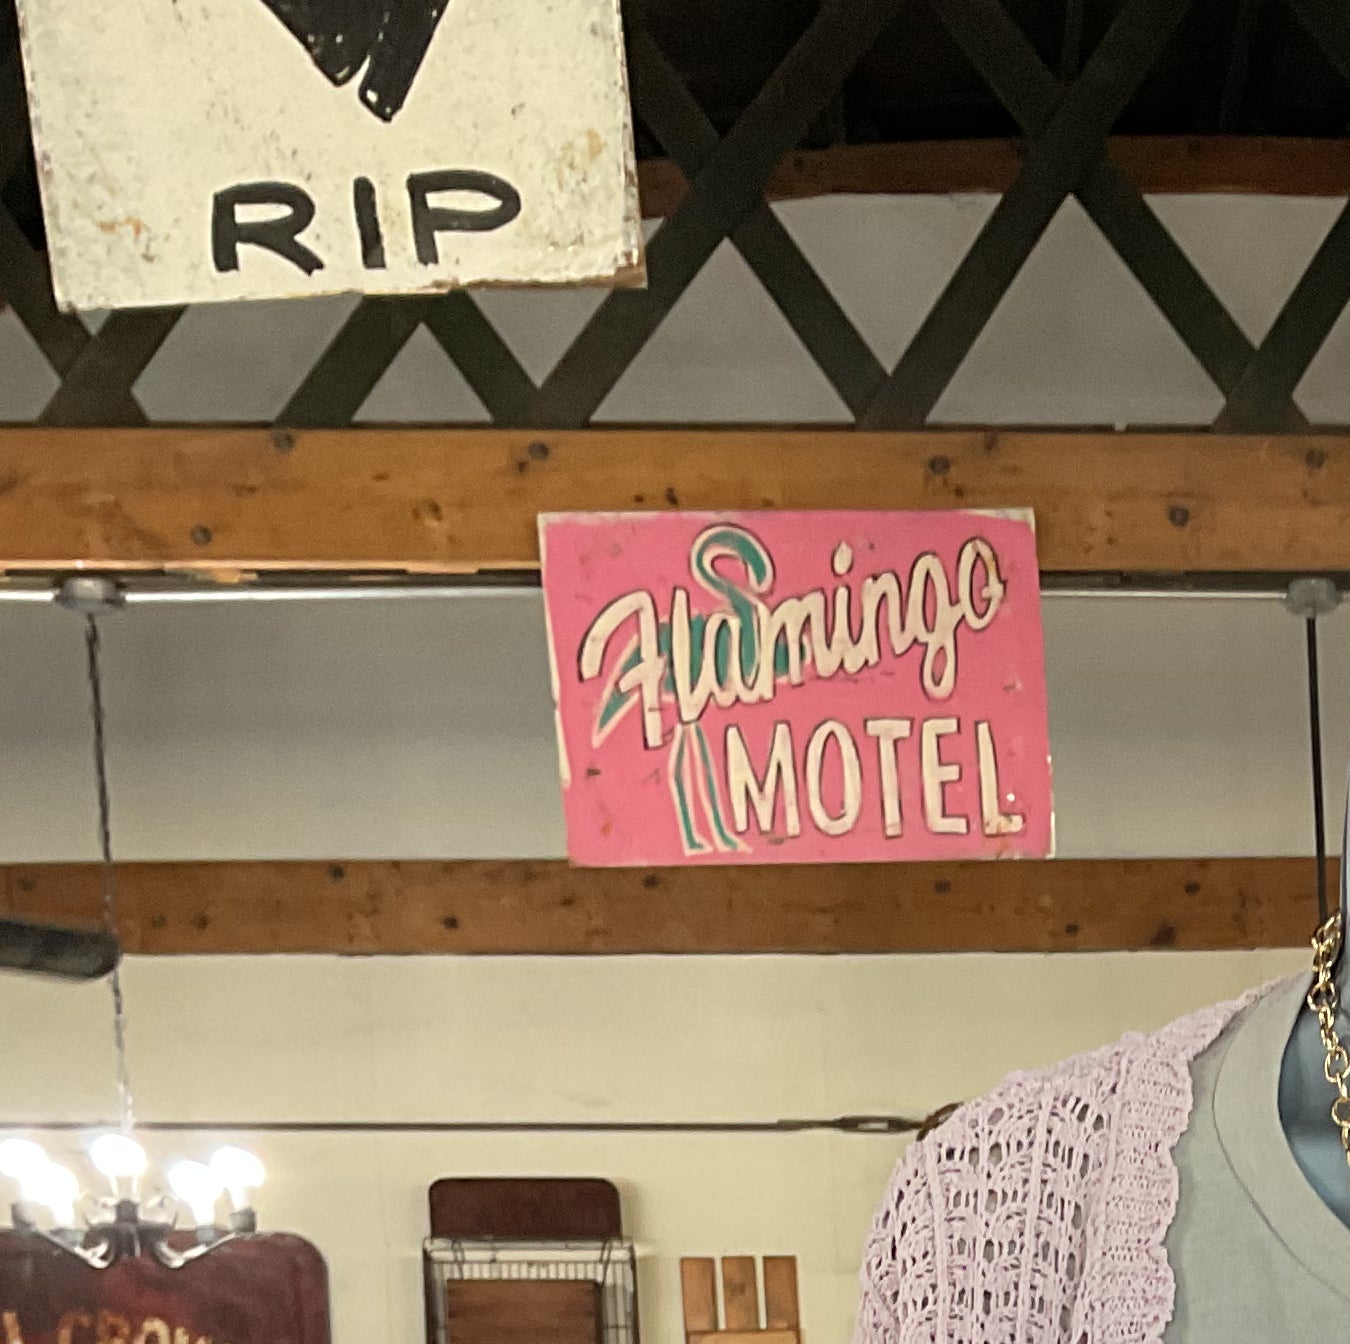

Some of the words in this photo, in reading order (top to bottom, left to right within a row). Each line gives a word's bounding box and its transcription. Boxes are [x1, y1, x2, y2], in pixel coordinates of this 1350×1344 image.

[212, 169, 522, 277] RIP
[577, 536, 1007, 749] Flamingo
[725, 717, 1023, 838] MOTEL
